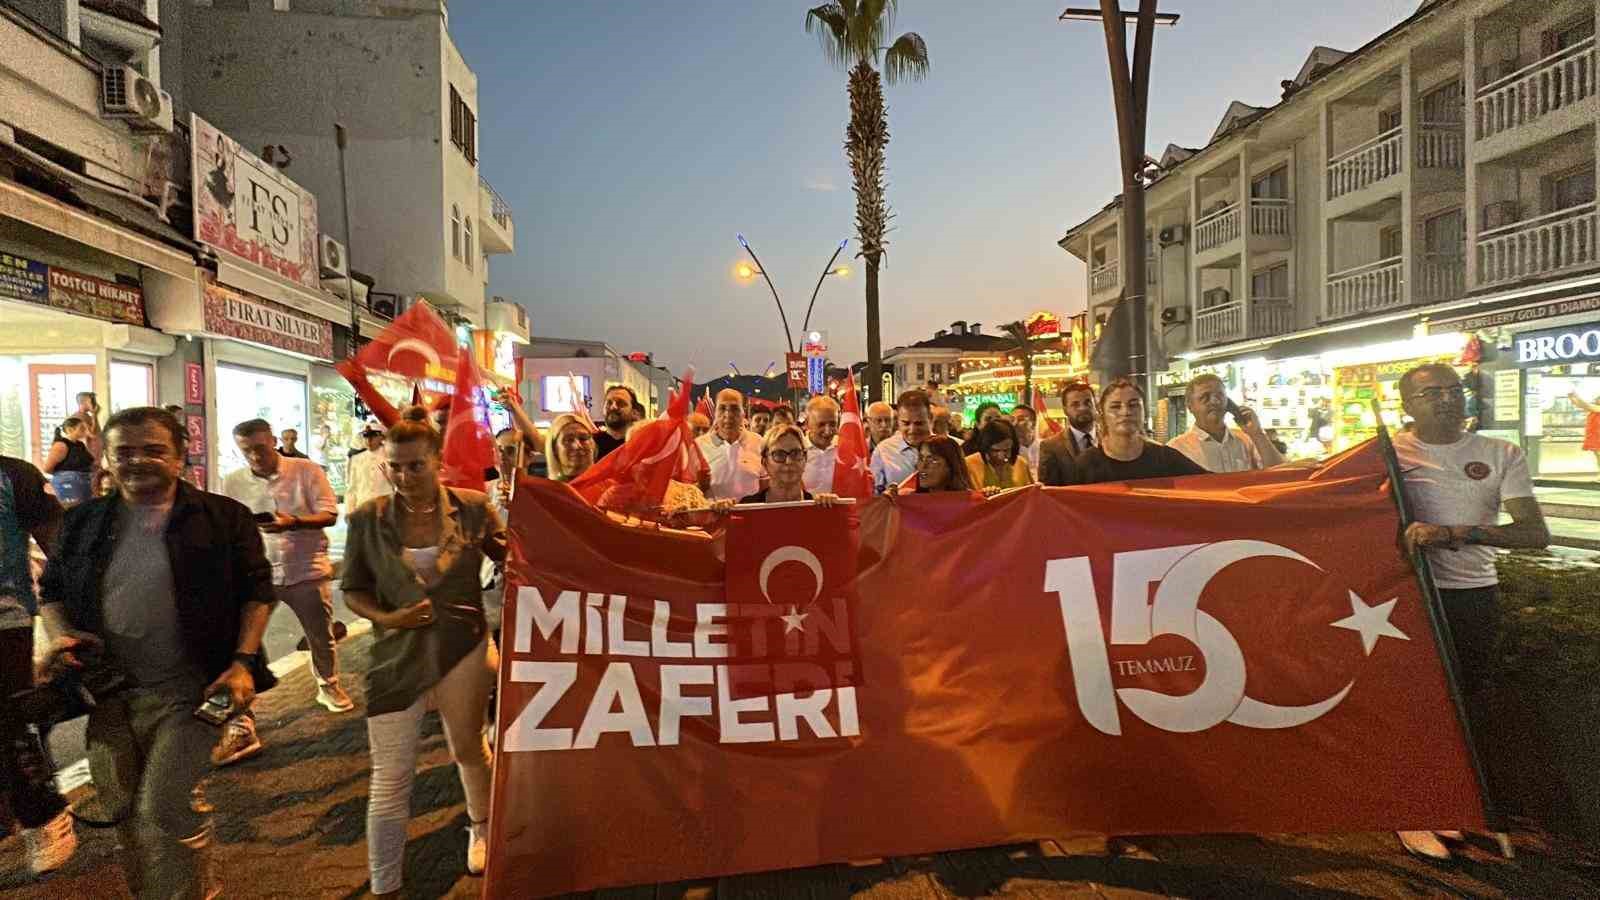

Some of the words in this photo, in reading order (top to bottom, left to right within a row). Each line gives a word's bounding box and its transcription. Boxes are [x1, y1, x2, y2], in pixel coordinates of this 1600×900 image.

[247, 176, 290, 247] FS
[228, 300, 273, 327] FIRAT
[1518, 306, 1546, 321] GOLD
[1116, 655, 1196, 676] TEMMUZ
